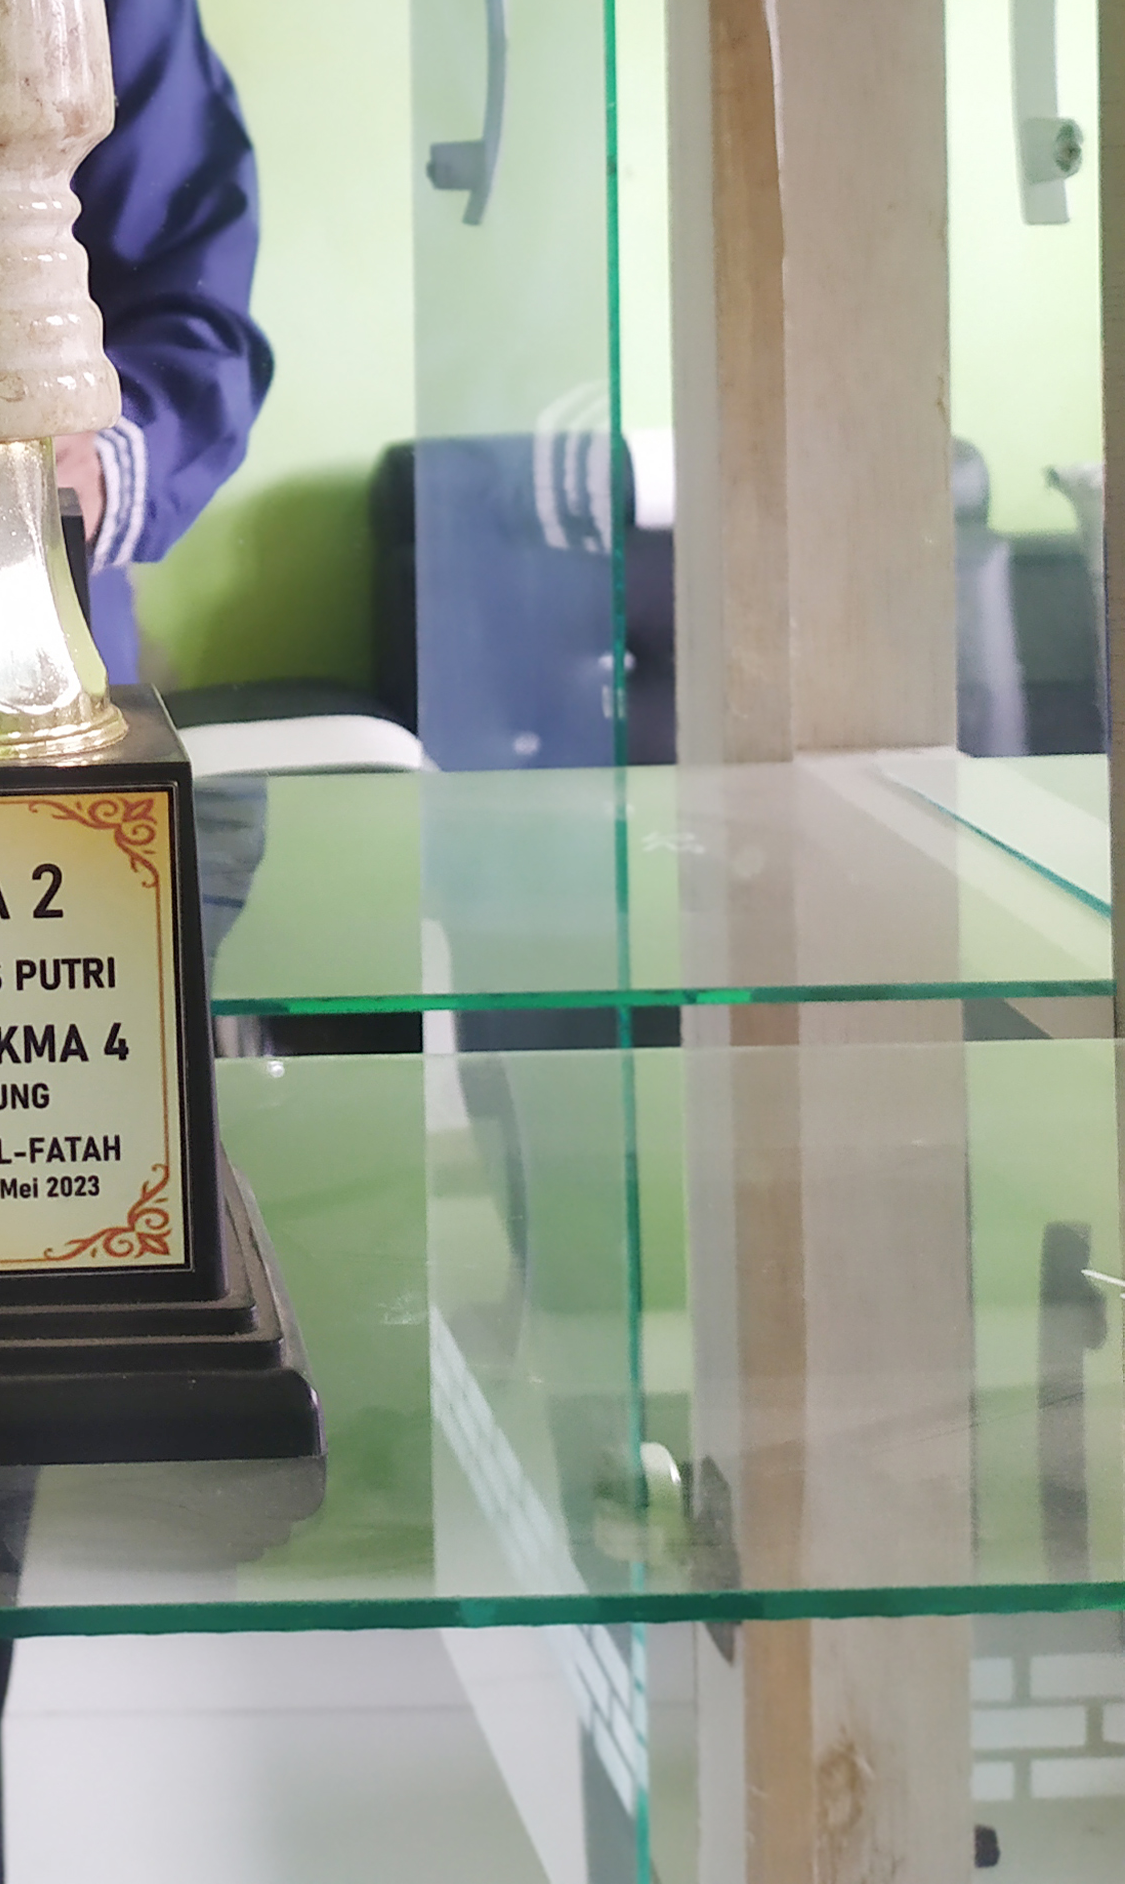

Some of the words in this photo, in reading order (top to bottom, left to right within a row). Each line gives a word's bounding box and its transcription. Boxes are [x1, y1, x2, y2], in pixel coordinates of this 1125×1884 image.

[31, 863, 64, 919] 2
[15, 956, 116, 991] PUTRI
[103, 1022, 130, 1061] 4
[0, 1177, 39, 1200] Mei
[46, 1175, 101, 1198] 2023
